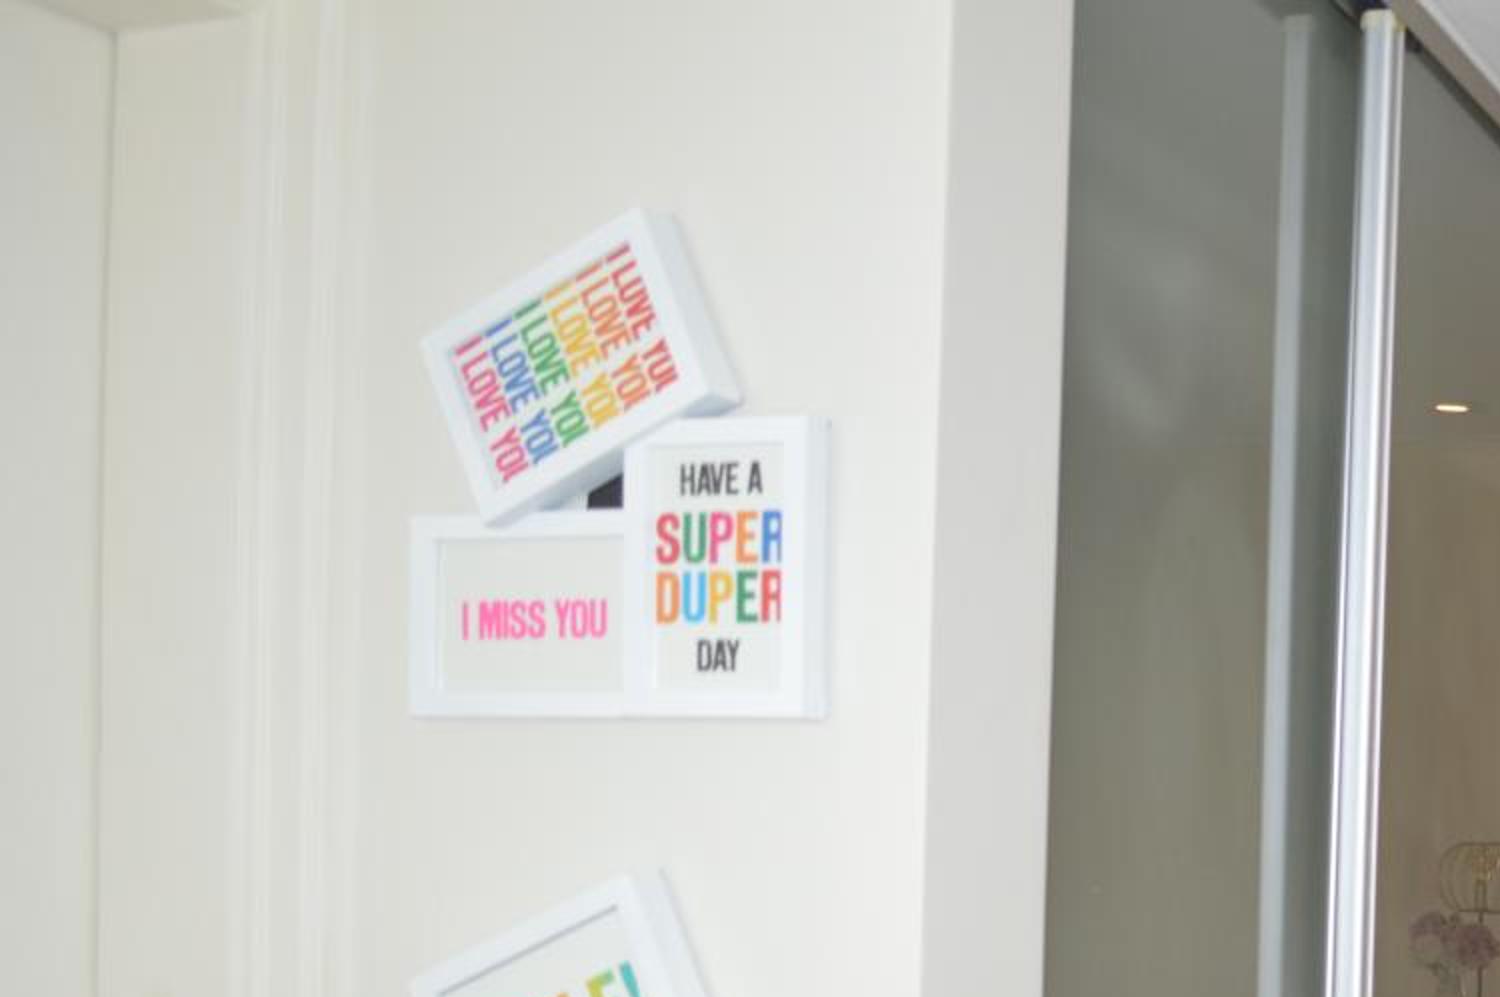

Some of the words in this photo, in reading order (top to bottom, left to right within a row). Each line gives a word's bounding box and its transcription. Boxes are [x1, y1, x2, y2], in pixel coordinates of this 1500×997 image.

[606, 242, 630, 262] I
[544, 280, 574, 300] I
[576, 261, 602, 282] I
[485, 318, 512, 336] I
[514, 299, 542, 318] I
[581, 276, 632, 356] LOVE
[456, 335, 484, 356] I
[521, 314, 570, 393] LOVE
[548, 295, 600, 374] LOVE
[462, 351, 510, 430] LOVE
[491, 333, 541, 412] LOVE
[680, 462, 739, 496] HAVE
[748, 460, 762, 494] A
[656, 509, 782, 564] SUPER
[656, 569, 781, 624] DUPER
[461, 602, 469, 640] I
[478, 600, 546, 639] MISS
[555, 599, 608, 638] YOU
[697, 639, 739, 671] DAY
